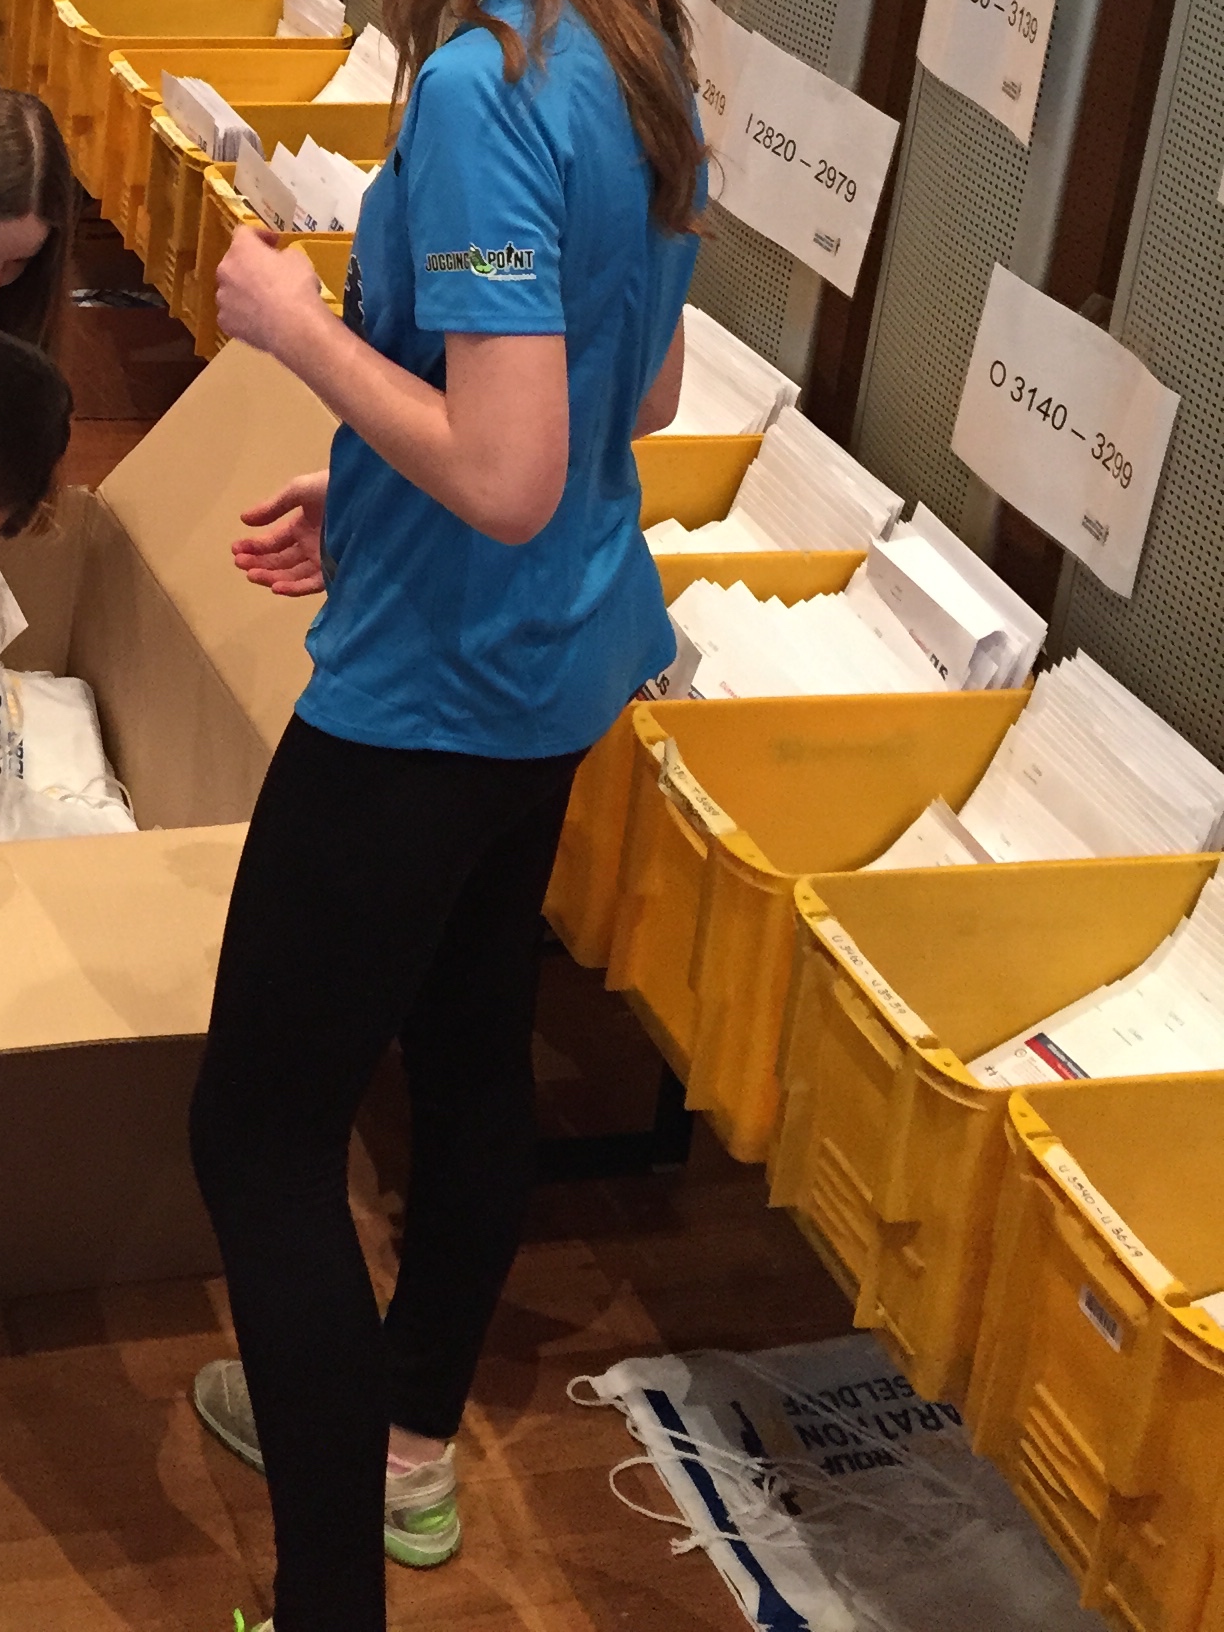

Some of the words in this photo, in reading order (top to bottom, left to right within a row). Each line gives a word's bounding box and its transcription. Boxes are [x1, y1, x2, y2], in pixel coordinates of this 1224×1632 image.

[1007, 0, 1038, 44] 3139
[702, 78, 726, 116] 2819
[752, 120, 797, 163] 2820
[813, 159, 857, 203] 2979
[426, 251, 471, 272] JOGGING
[989, 359, 1007, 388] O
[1010, 376, 1068, 431] 3140
[1091, 432, 1133, 489] 3299
